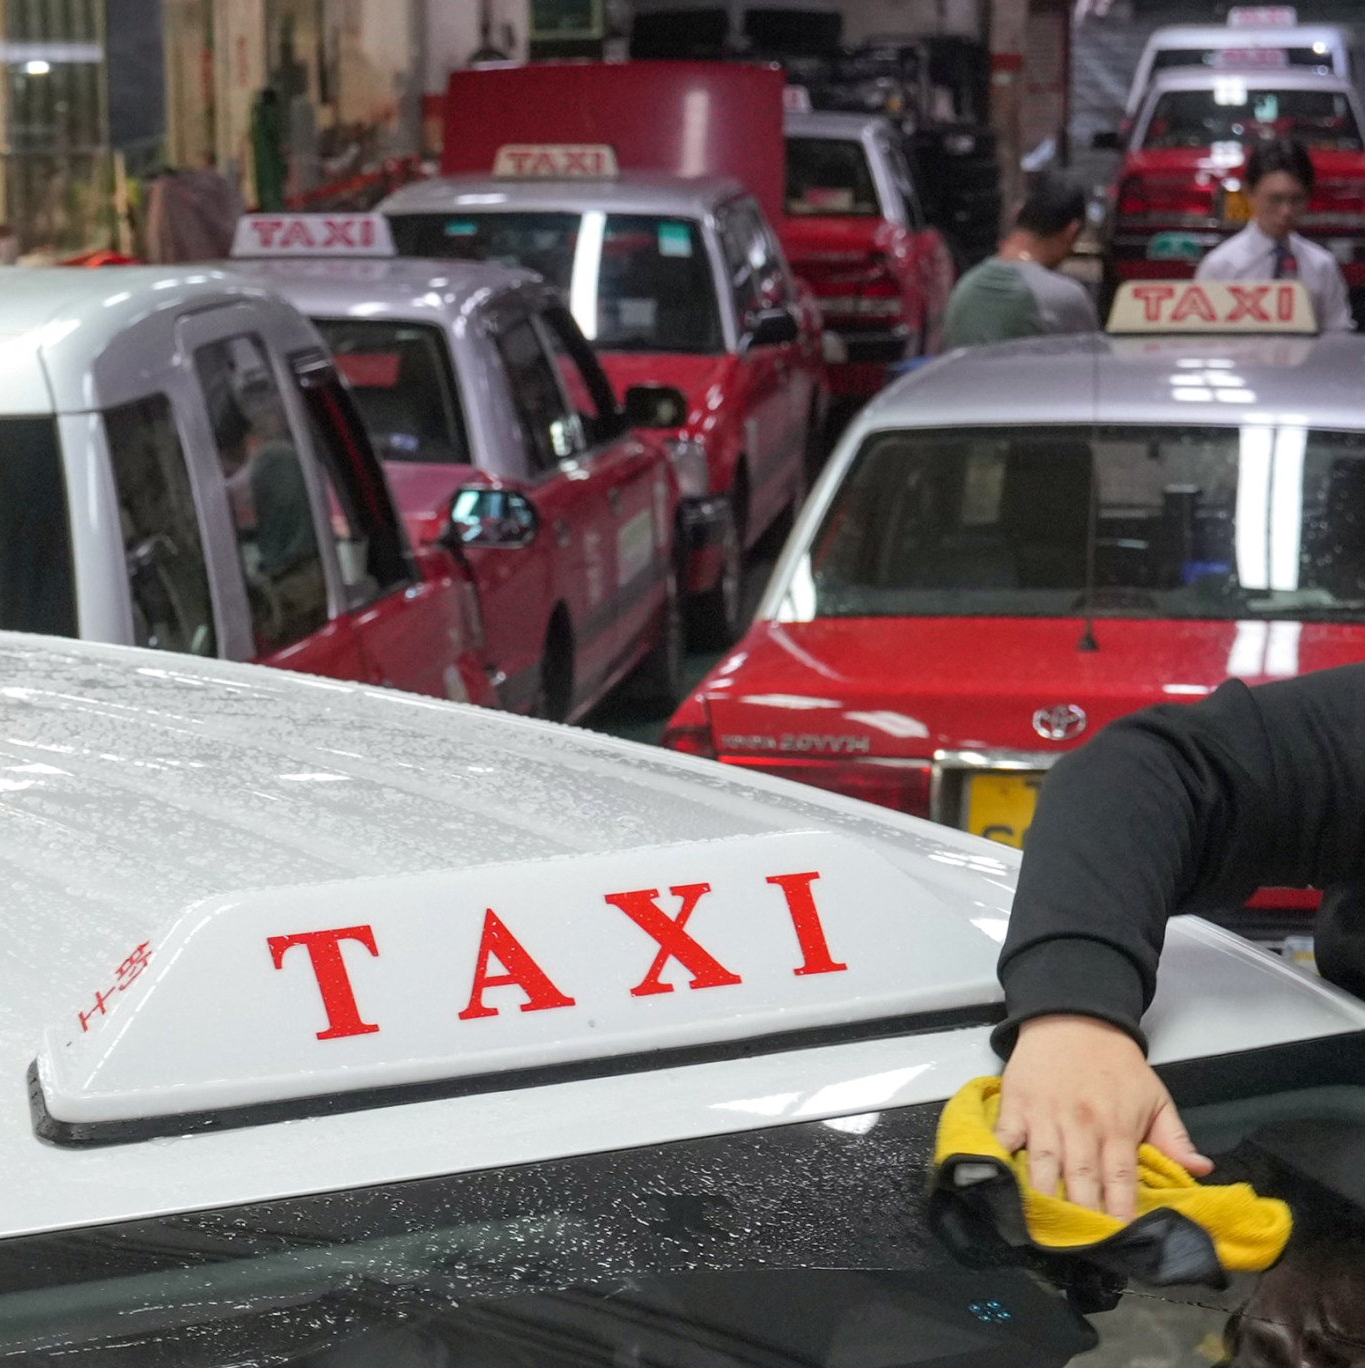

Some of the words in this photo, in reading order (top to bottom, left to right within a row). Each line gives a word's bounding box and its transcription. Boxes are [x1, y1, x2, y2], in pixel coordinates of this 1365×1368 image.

[508, 153, 603, 176] TAXI
[253, 219, 375, 248] TAXI
[1131, 283, 1297, 325] TAXI
[267, 870, 849, 1041] TAXI
[78, 941, 154, 1032] 的士
